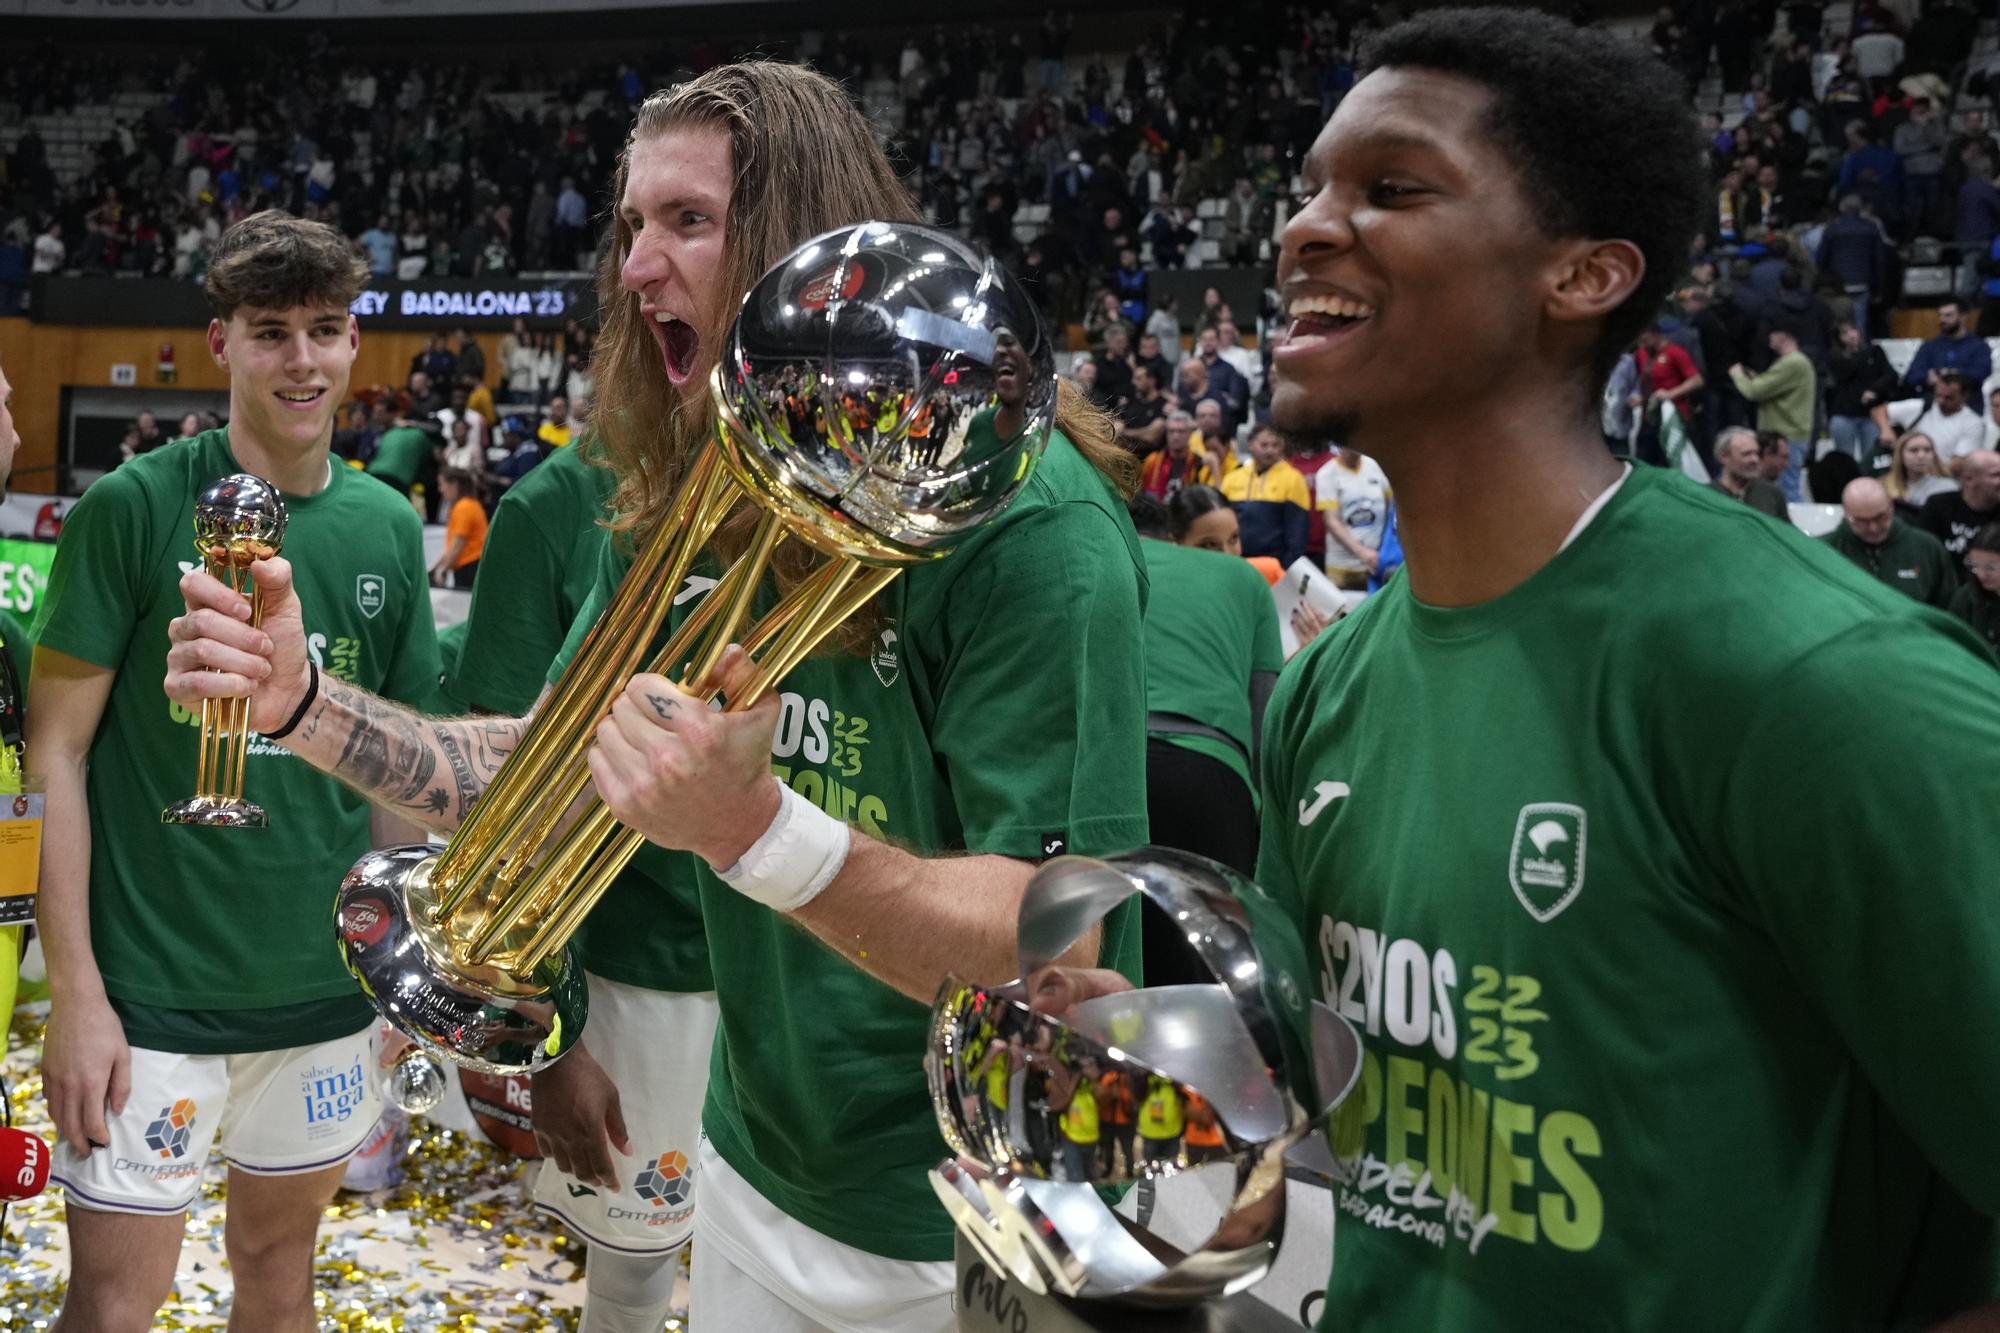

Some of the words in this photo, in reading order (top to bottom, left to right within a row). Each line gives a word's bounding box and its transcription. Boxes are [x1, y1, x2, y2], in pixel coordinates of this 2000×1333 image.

[833, 710, 871, 744] 22
[831, 740, 863, 777] 23
[1463, 965, 1550, 1022] 22
[1464, 1017, 1541, 1081] 23
[300, 1066, 334, 1079] sabor
[506, 1077, 533, 1111] Re
[17, 1137, 38, 1187] rne
